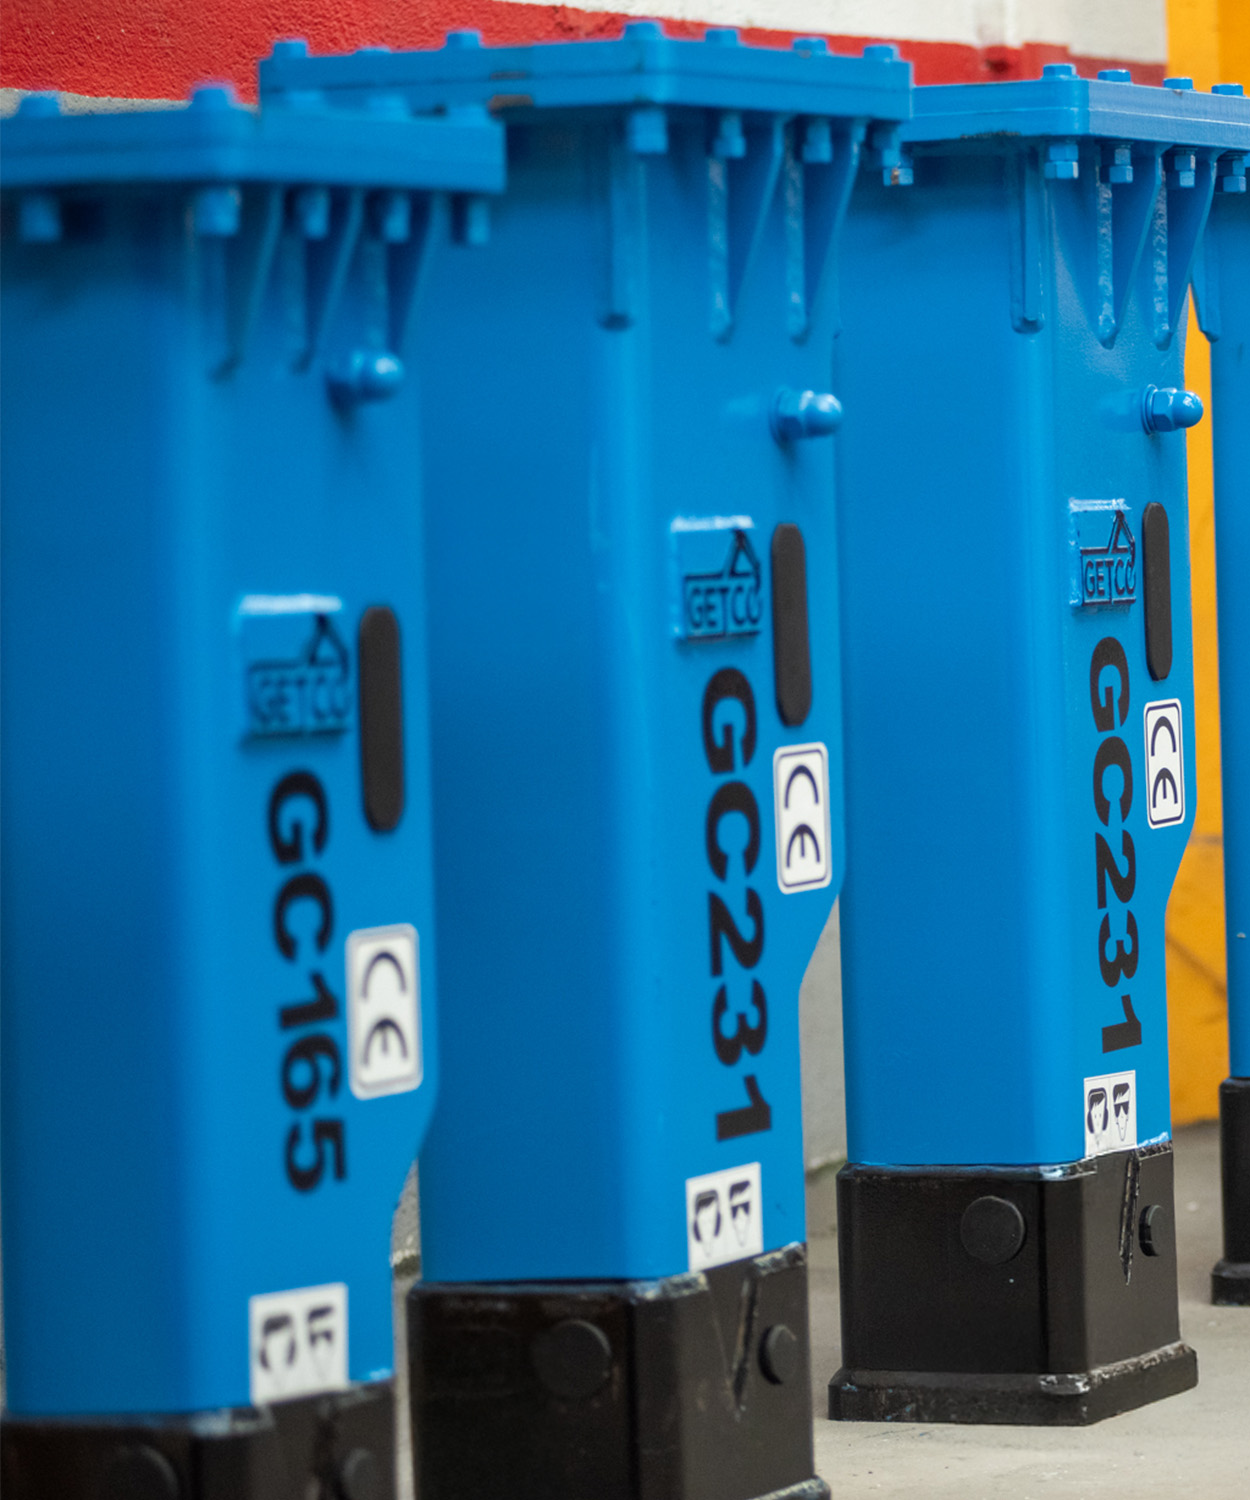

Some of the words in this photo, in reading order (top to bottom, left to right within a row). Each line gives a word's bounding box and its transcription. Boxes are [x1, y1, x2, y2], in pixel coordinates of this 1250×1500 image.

[687, 587, 762, 629] GETCO
[1085, 558, 1137, 598] GETCO
[784, 763, 821, 870] CE
[1150, 715, 1178, 809] CE
[1089, 636, 1143, 1054] GC231
[701, 667, 772, 1141] GC231
[267, 768, 347, 1193] GC165
[361, 950, 409, 1069] CE
